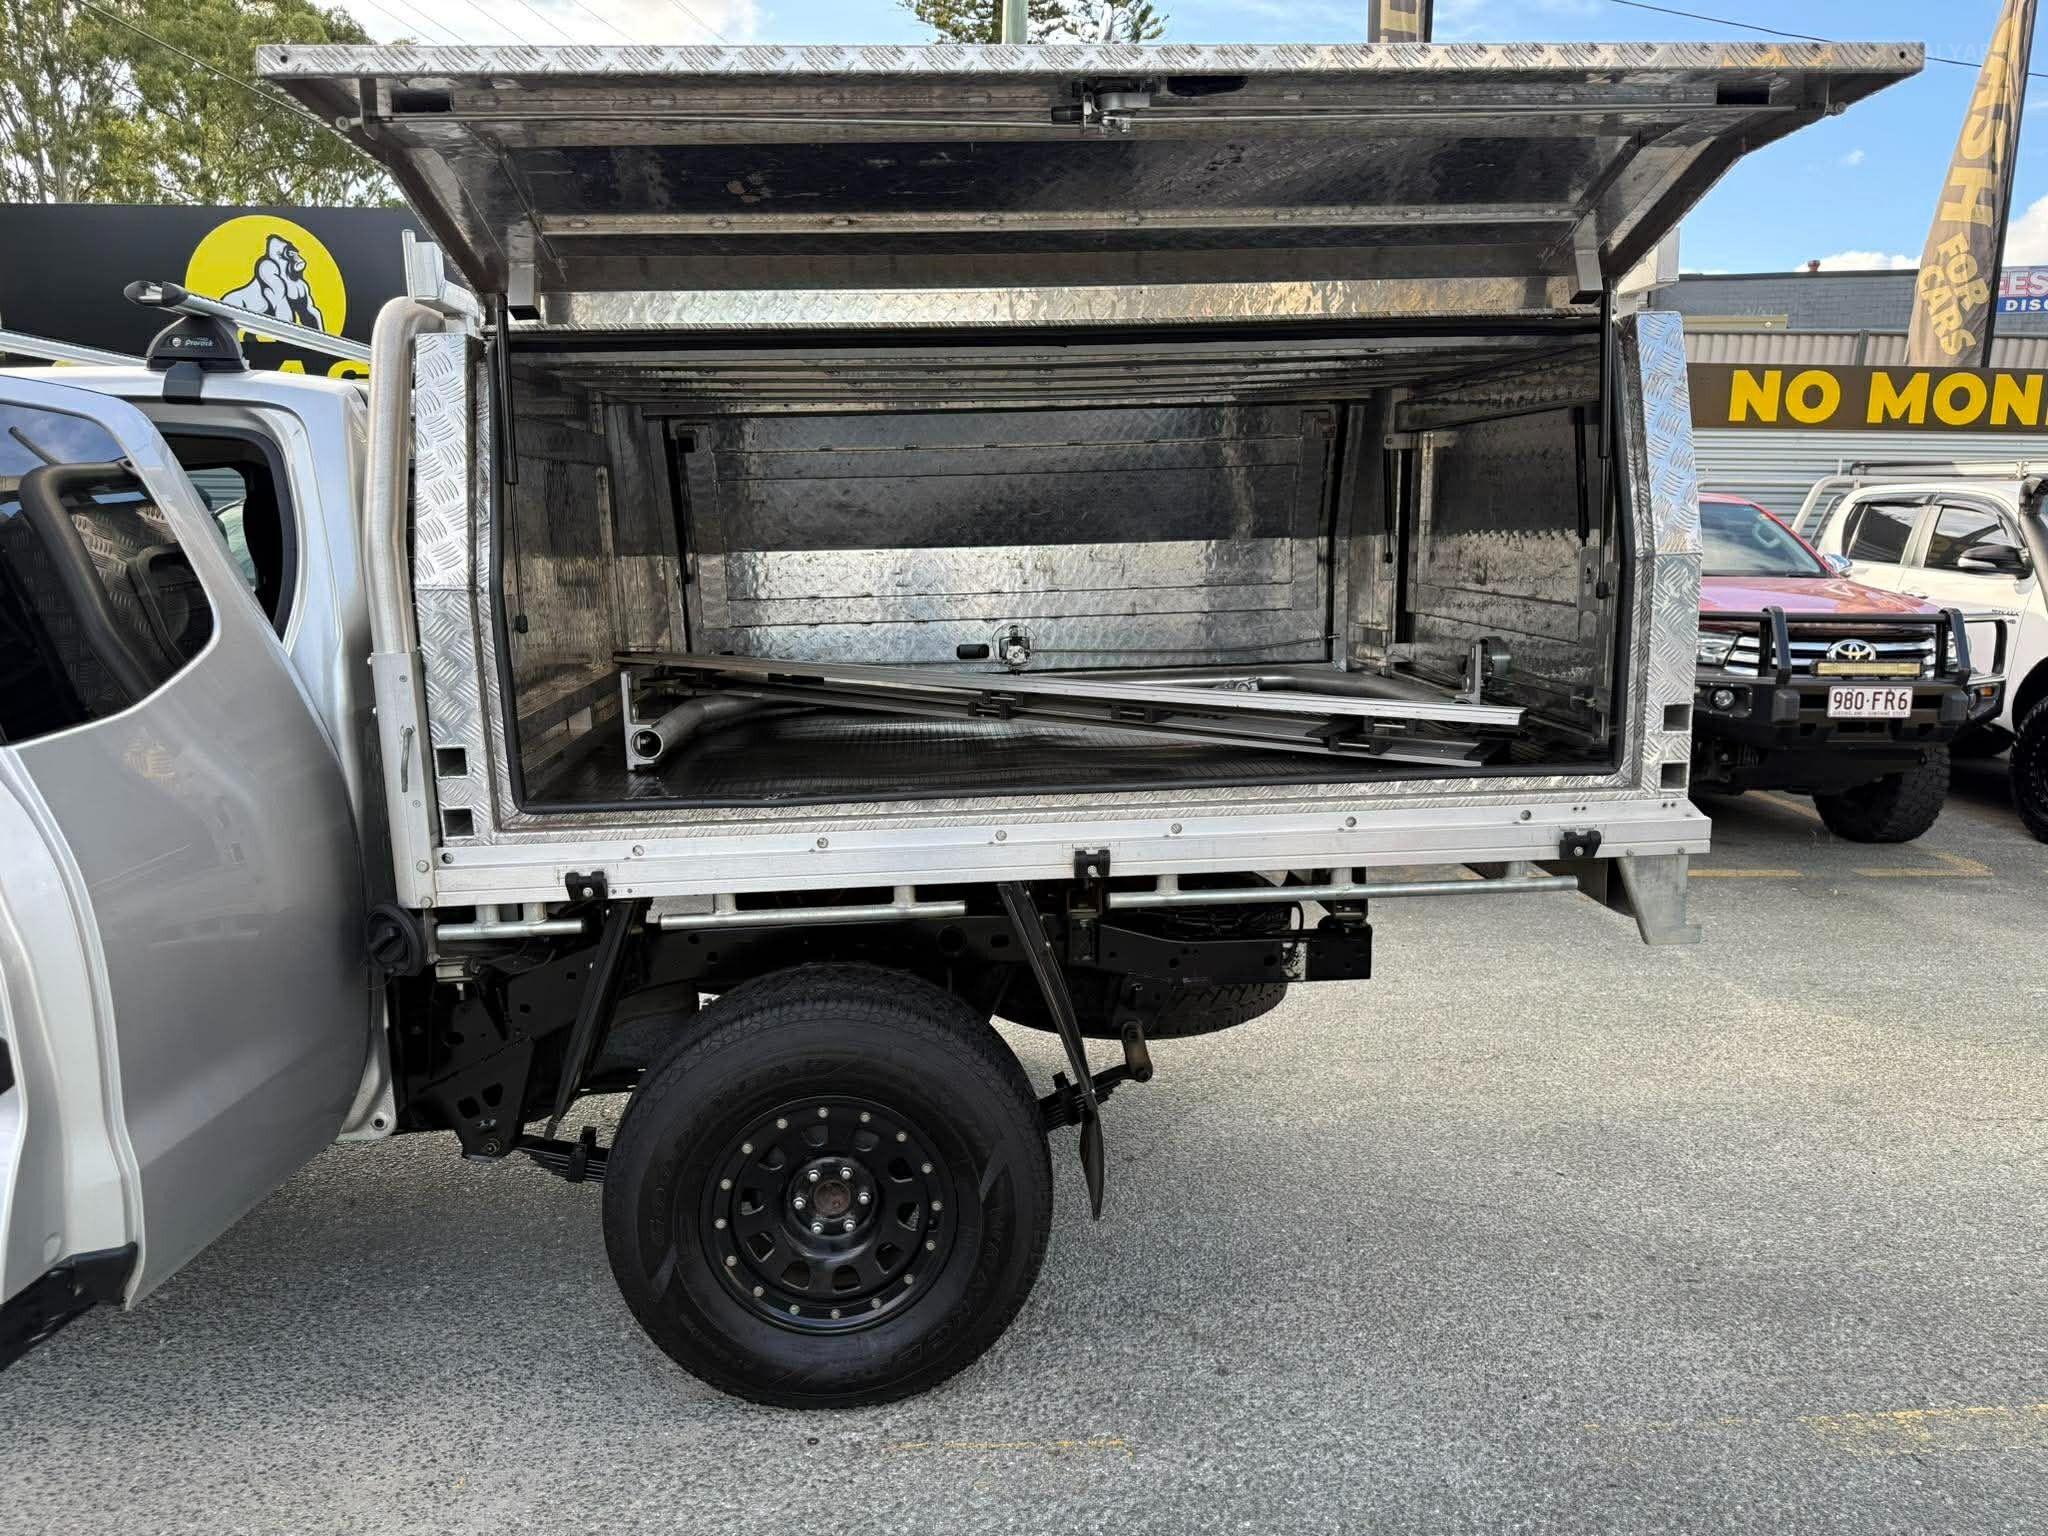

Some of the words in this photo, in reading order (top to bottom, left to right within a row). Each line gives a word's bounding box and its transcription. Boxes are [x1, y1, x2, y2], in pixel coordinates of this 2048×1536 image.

[1919, 264, 1977, 356] CARS
[1937, 232, 1990, 312] FOR
[1728, 369, 1841, 423] NO
[1866, 372, 2048, 426] MON
